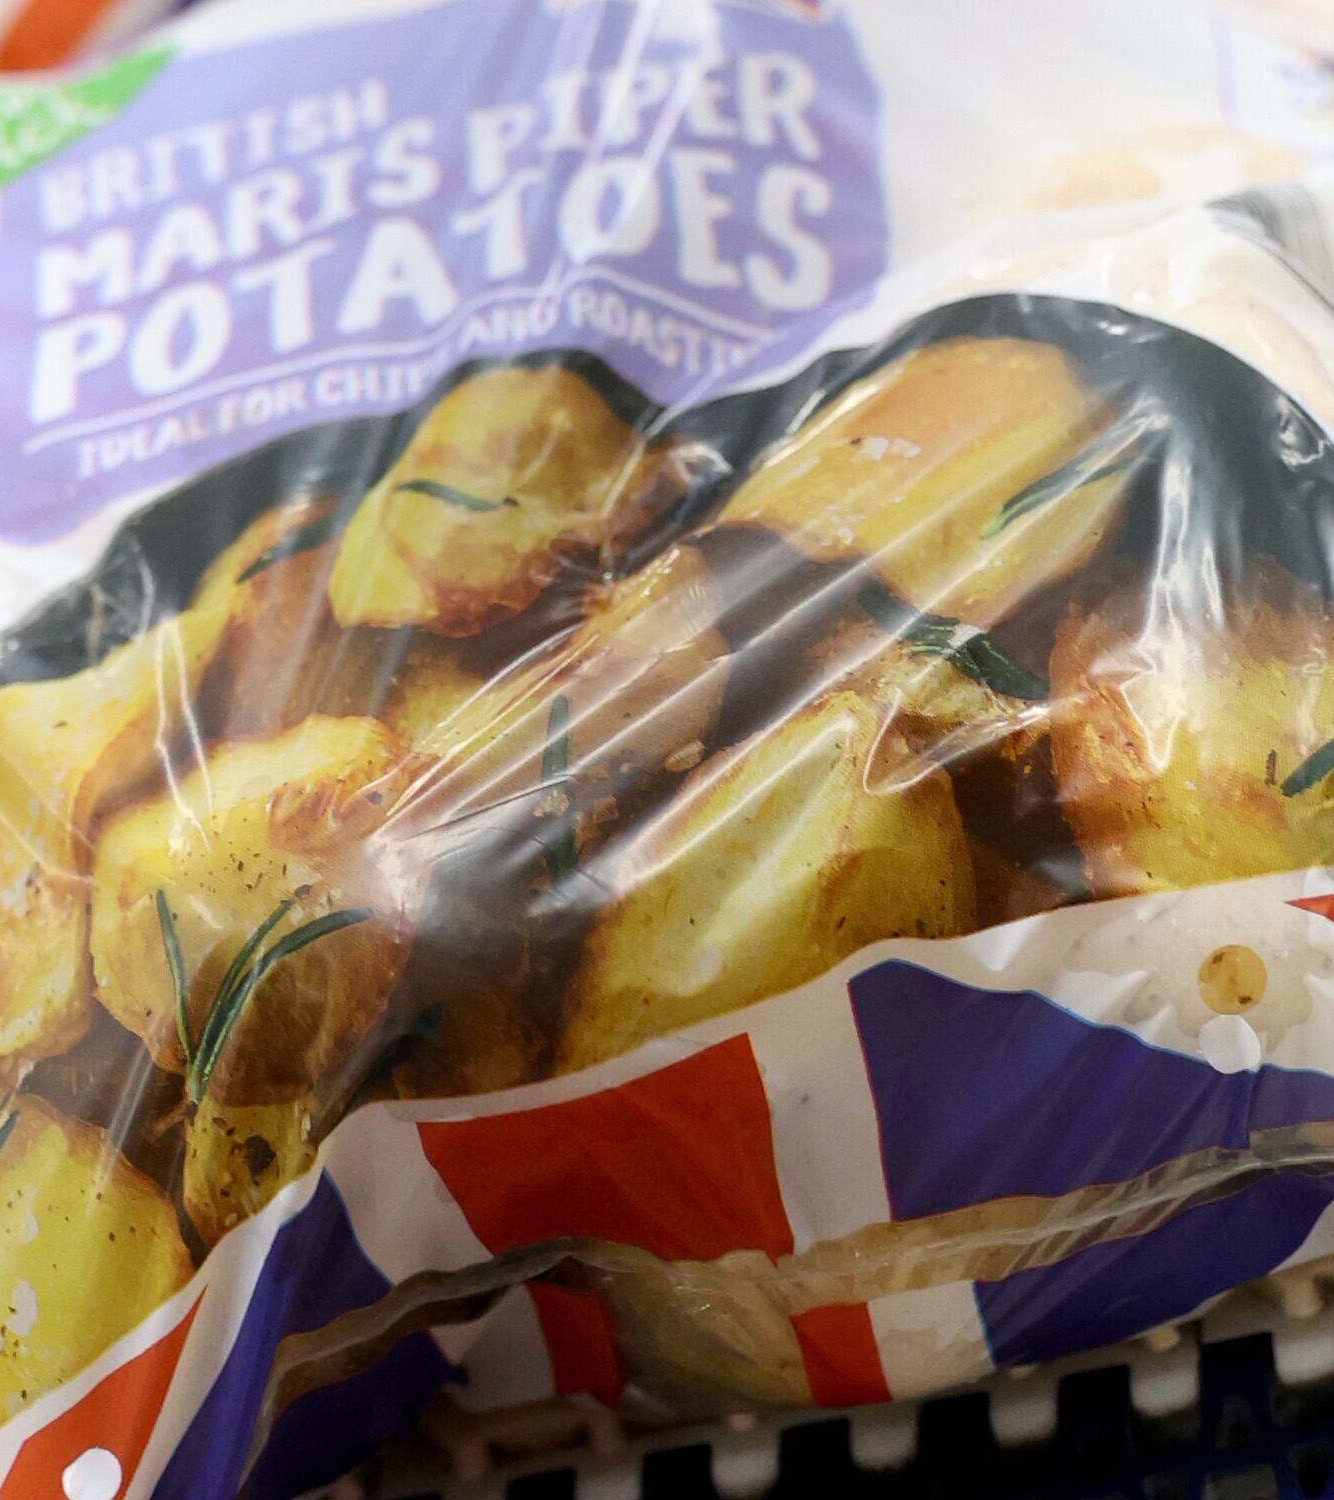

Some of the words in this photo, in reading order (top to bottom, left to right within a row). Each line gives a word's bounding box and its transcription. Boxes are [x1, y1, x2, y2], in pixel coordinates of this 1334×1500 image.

[37, 117, 440, 318] MARIS
[469, 50, 823, 196] PIPER
[41, 78, 387, 230] BRITISH
[29, 148, 835, 424] POTATOES
[216, 376, 305, 440] FOR
[457, 298, 559, 352] AND
